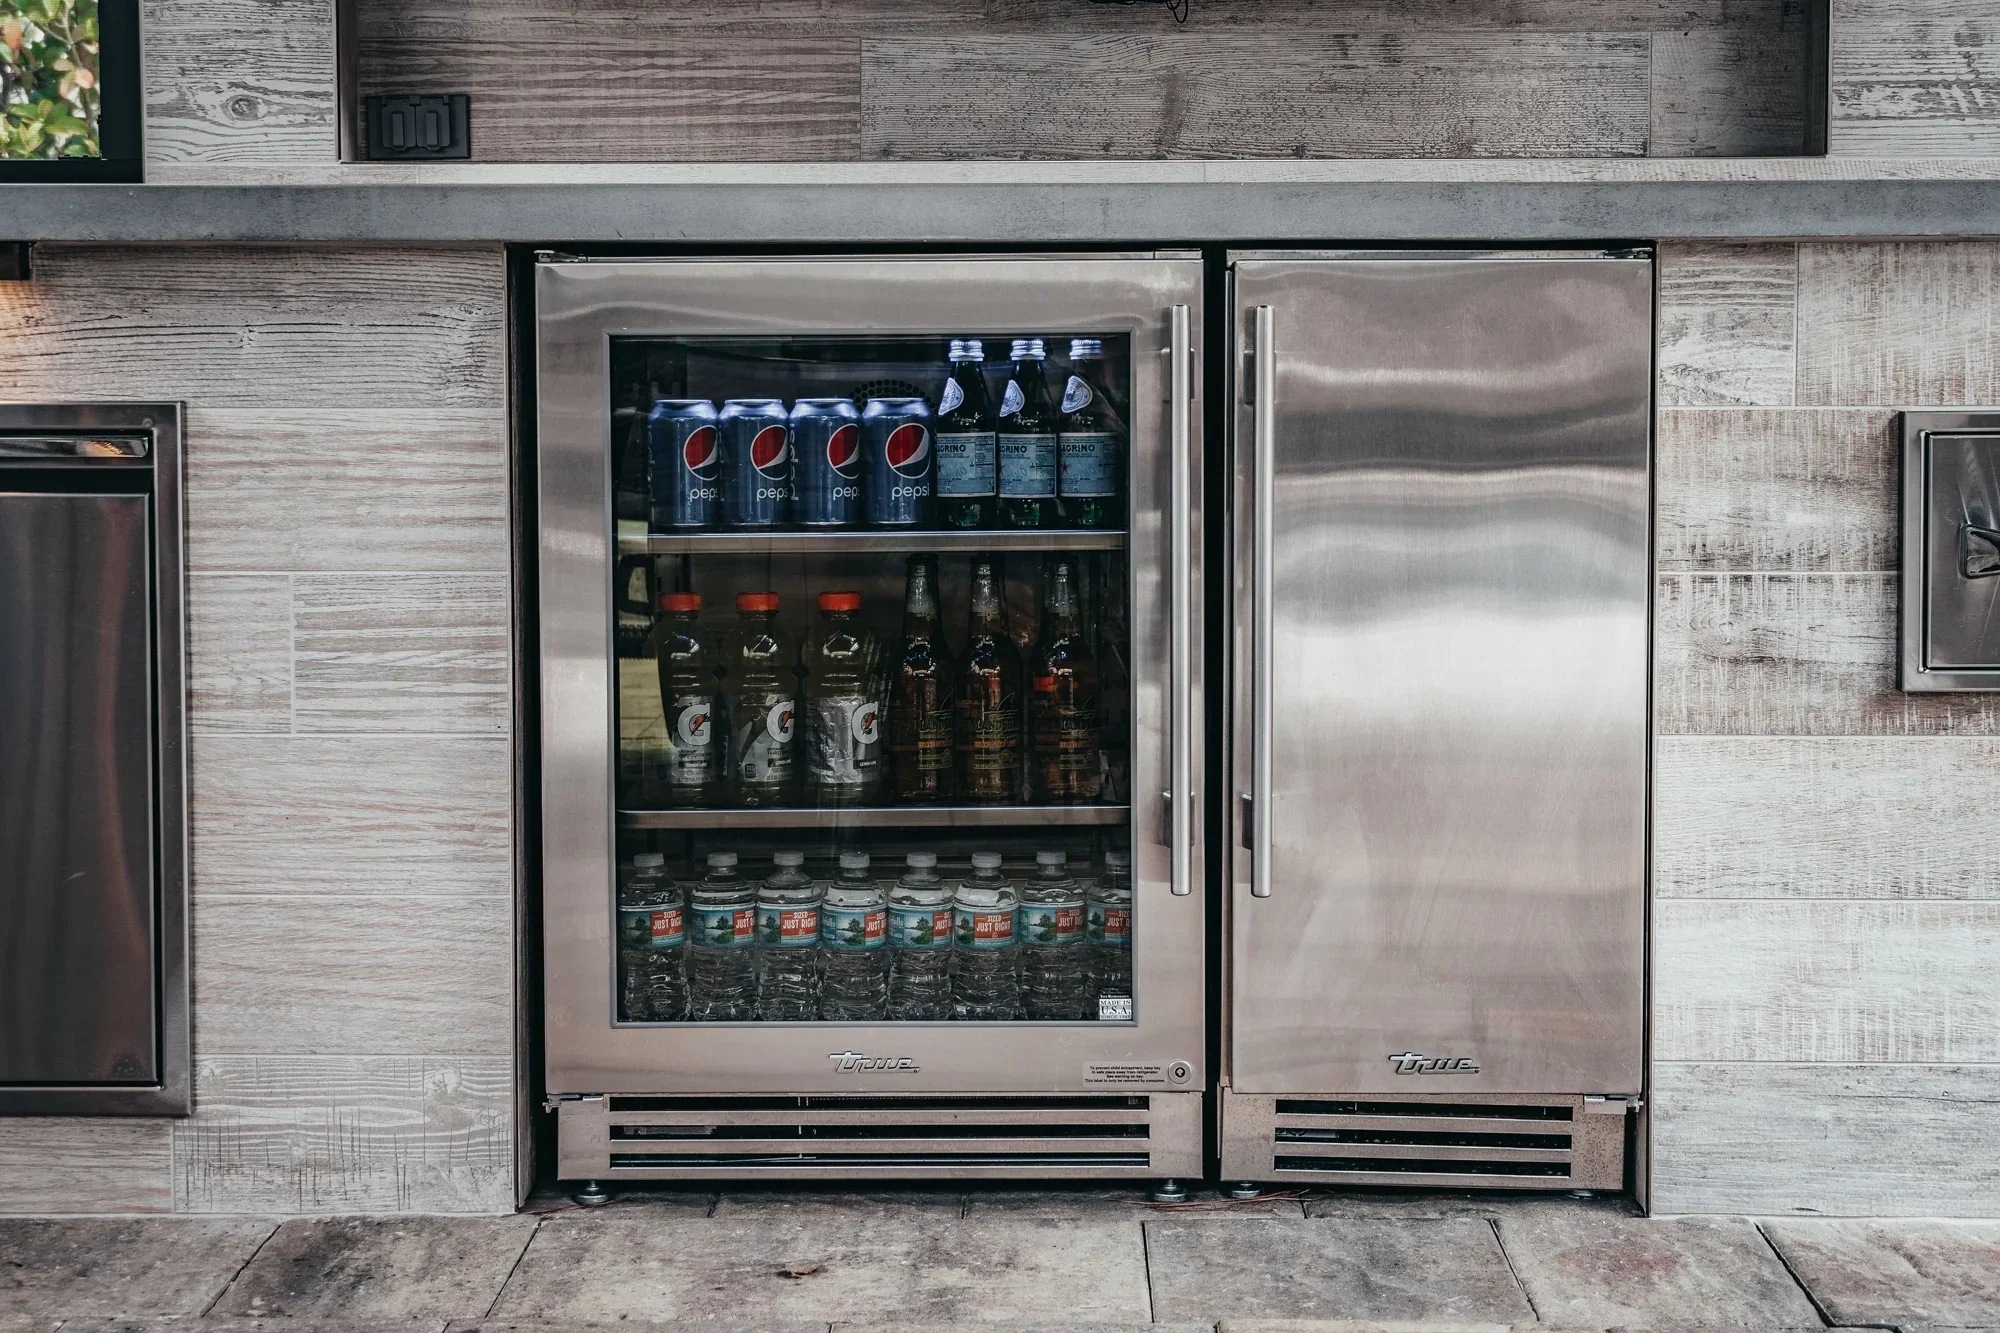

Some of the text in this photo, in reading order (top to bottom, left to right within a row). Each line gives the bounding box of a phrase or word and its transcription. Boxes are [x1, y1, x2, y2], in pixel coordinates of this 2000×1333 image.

[891, 482, 930, 500] pepsi
[677, 702, 711, 747] G
[766, 700, 795, 743] G
[851, 701, 878, 745] G
[663, 910, 676, 919] SIZED
[793, 911, 808, 919] SIZED
[653, 919, 669, 930] JUST
[735, 918, 749, 929] JUST
[782, 919, 799, 929] JUST
[801, 917, 817, 929] RIGHT
[867, 920, 880, 931] JUST
[935, 918, 948, 930] JUST
[976, 920, 1011, 932] JUST RIGHT
[1058, 916, 1074, 927] JUST
[1106, 916, 1124, 927] JUST
[1101, 1006, 1131, 1015] U.S.A.
